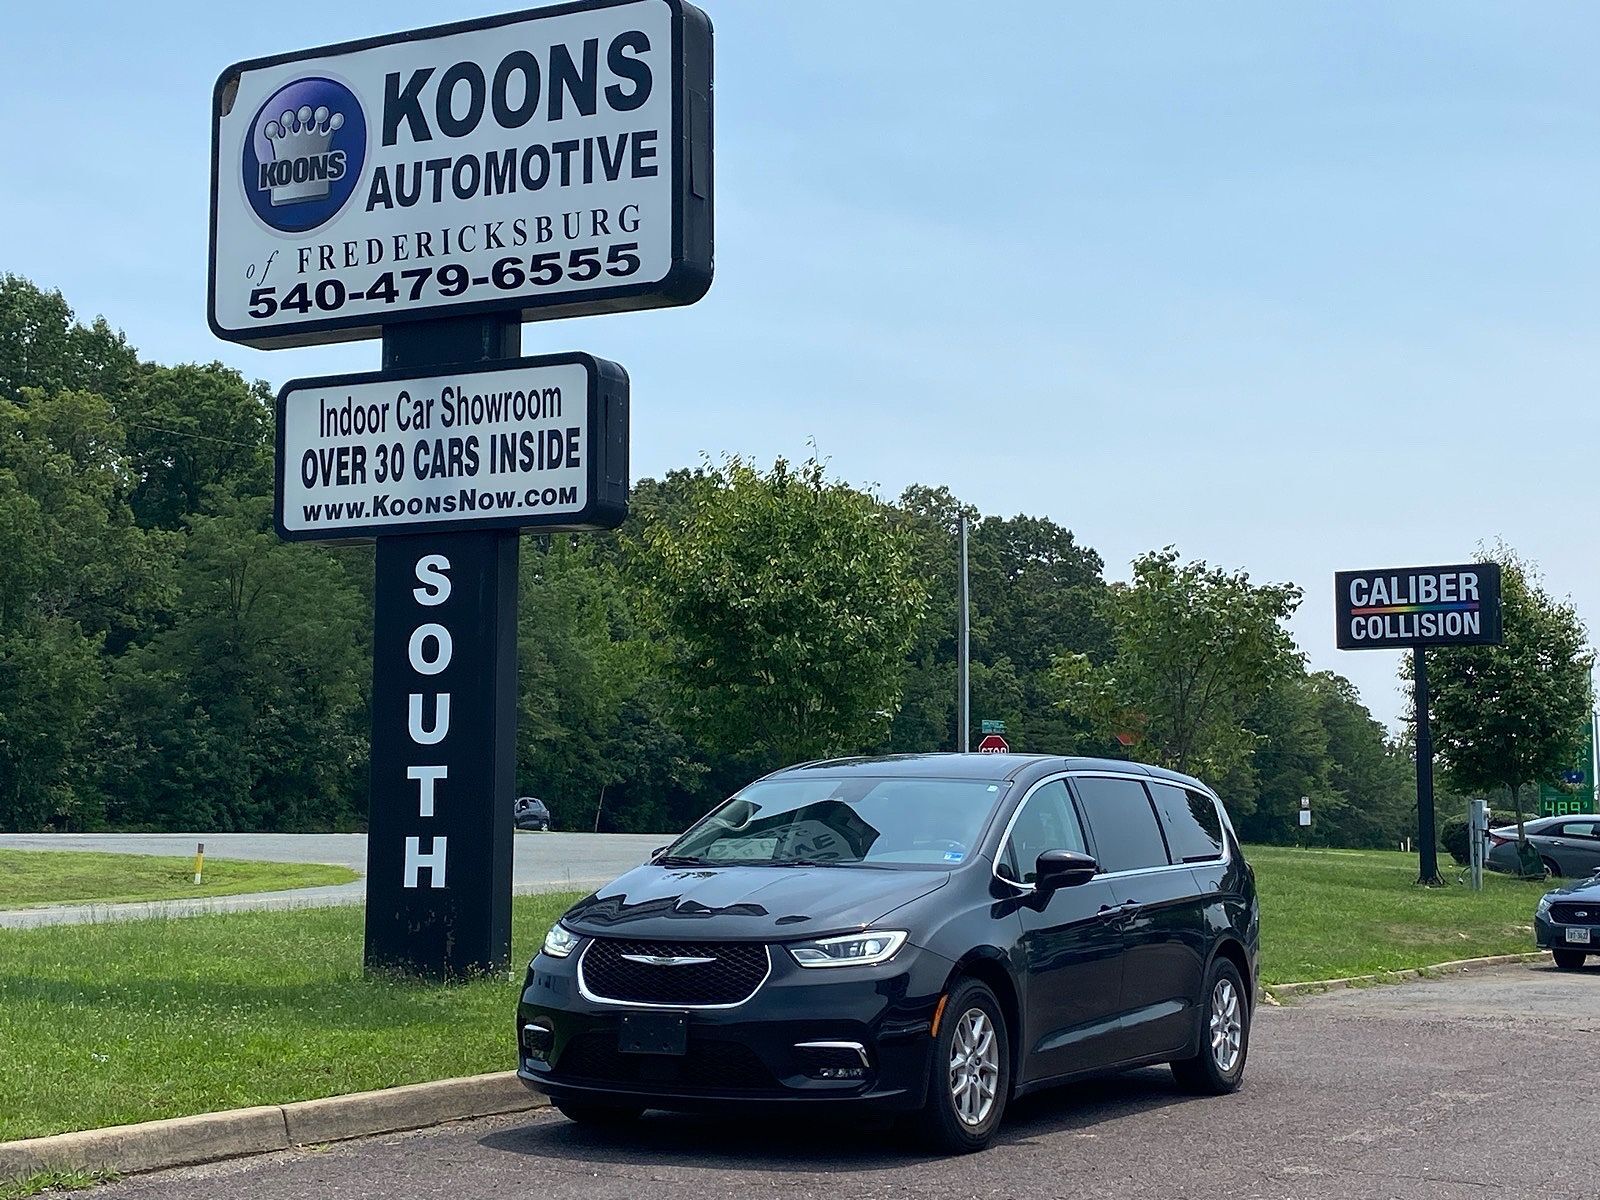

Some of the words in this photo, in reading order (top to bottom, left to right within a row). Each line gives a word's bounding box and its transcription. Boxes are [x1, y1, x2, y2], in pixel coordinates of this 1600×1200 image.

[381, 30, 653, 147] KOONS
[259, 151, 346, 190] KOONS
[365, 129, 659, 213] AUTOMOTIVE
[246, 249, 279, 287] of
[296, 204, 642, 274] FREDERICKSBURG
[247, 242, 641, 319] 540-479-6555
[319, 396, 389, 438] Indoor
[396, 390, 432, 432] Car
[441, 385, 562, 428] Showroom
[301, 444, 367, 489] OVER
[374, 442, 405, 483] 30
[413, 434, 479, 481] CARS
[489, 426, 581, 475] INSIDE
[1350, 572, 1479, 607] CALIBER
[1351, 611, 1480, 640] COLLISION
[403, 553, 453, 889] SOUTH
